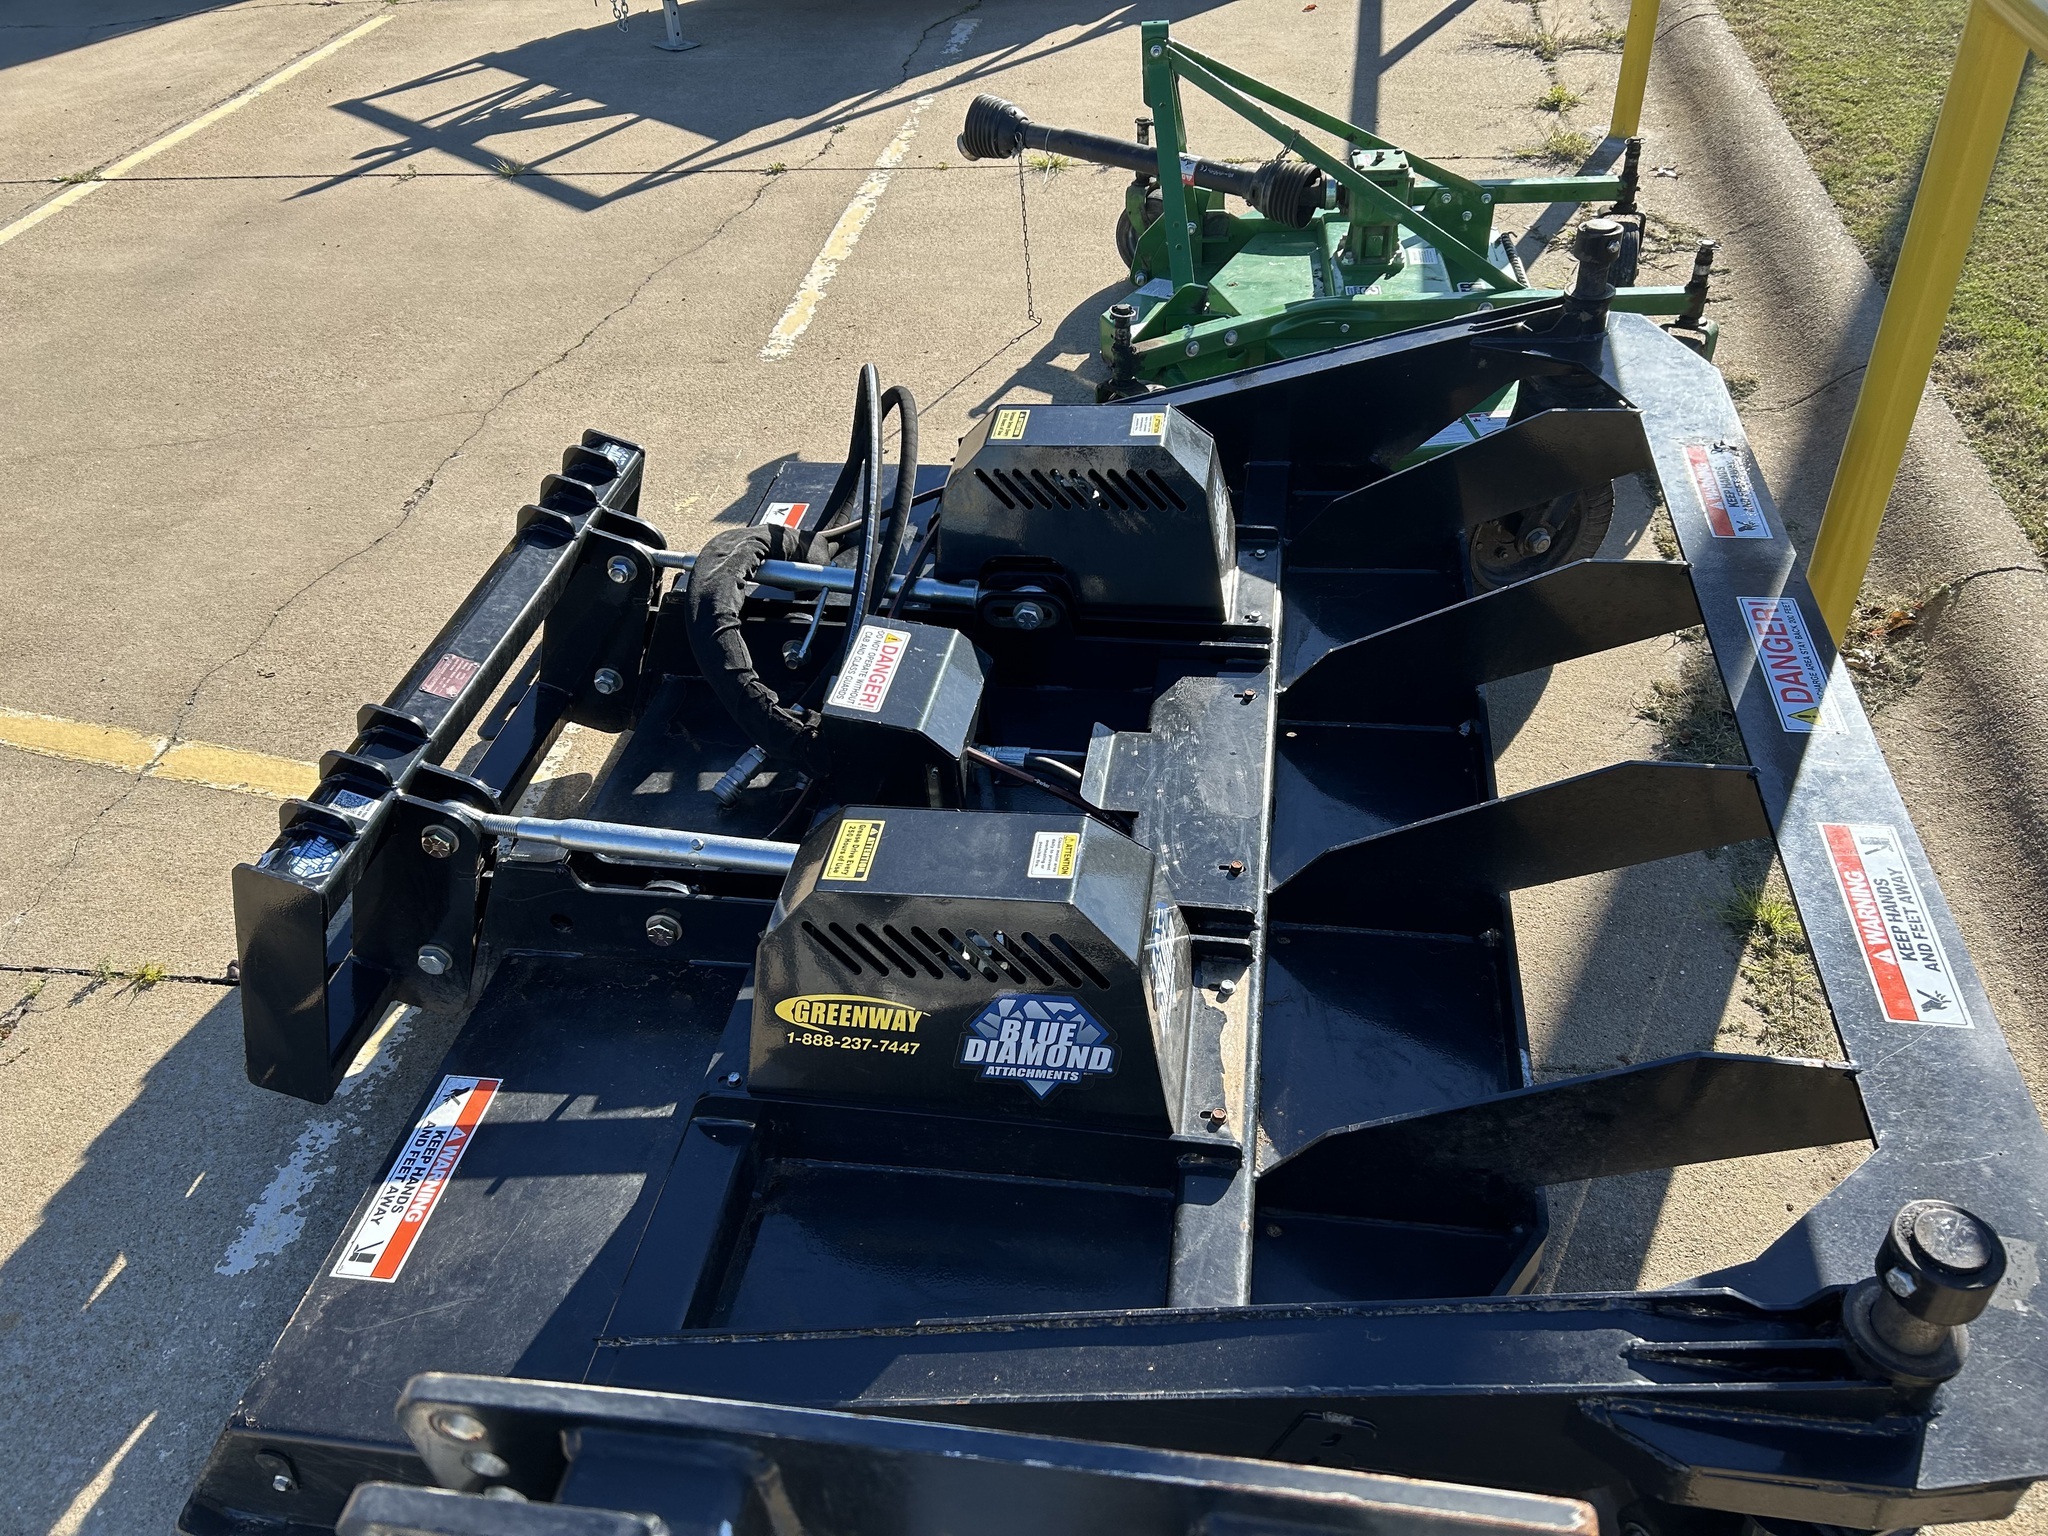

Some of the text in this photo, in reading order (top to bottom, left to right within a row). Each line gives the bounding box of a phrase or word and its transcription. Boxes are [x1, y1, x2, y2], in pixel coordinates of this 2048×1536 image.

[1715, 466, 1740, 508] KEEP HANDS
[1782, 602, 1792, 617] FEET
[1788, 616, 1796, 626] 200
[863, 632, 873, 643] CAB
[1792, 624, 1803, 640] BACK
[857, 643, 867, 655] AND
[1748, 601, 1814, 703] DANGER!
[1798, 641, 1808, 655] STAY
[1802, 656, 1814, 671] AREA
[847, 630, 885, 705] DO NOT OPERATE WITHOUT
[848, 656, 861, 675] GLASS
[858, 644, 898, 708] DANGER!
[836, 676, 854, 700] GUARDS
[1809, 671, 1827, 706] SCHARGE
[840, 838, 852, 854] Hours
[841, 824, 866, 875] Grease Drive Every
[857, 836, 876, 872] ATTENTION
[1061, 844, 1073, 874] ATTENTION
[833, 862, 843, 873] Use
[1844, 870, 1888, 946] WARNING
[1873, 878, 1918, 962] KEEP HANDS
[1888, 867, 1940, 972] AND FEET AWAY
[795, 1000, 924, 1033] GREENWAY
[786, 1032, 920, 1056] 1-888-237-7447
[998, 1018, 1079, 1047] BLUE
[964, 1038, 1112, 1072] DIAMOND
[985, 1065, 1080, 1082] ATTACHMENTS
[371, 1120, 436, 1226] AND FEET AWAY
[390, 1129, 447, 1214] KEEP HANDS
[404, 1144, 461, 1223] WARNING
